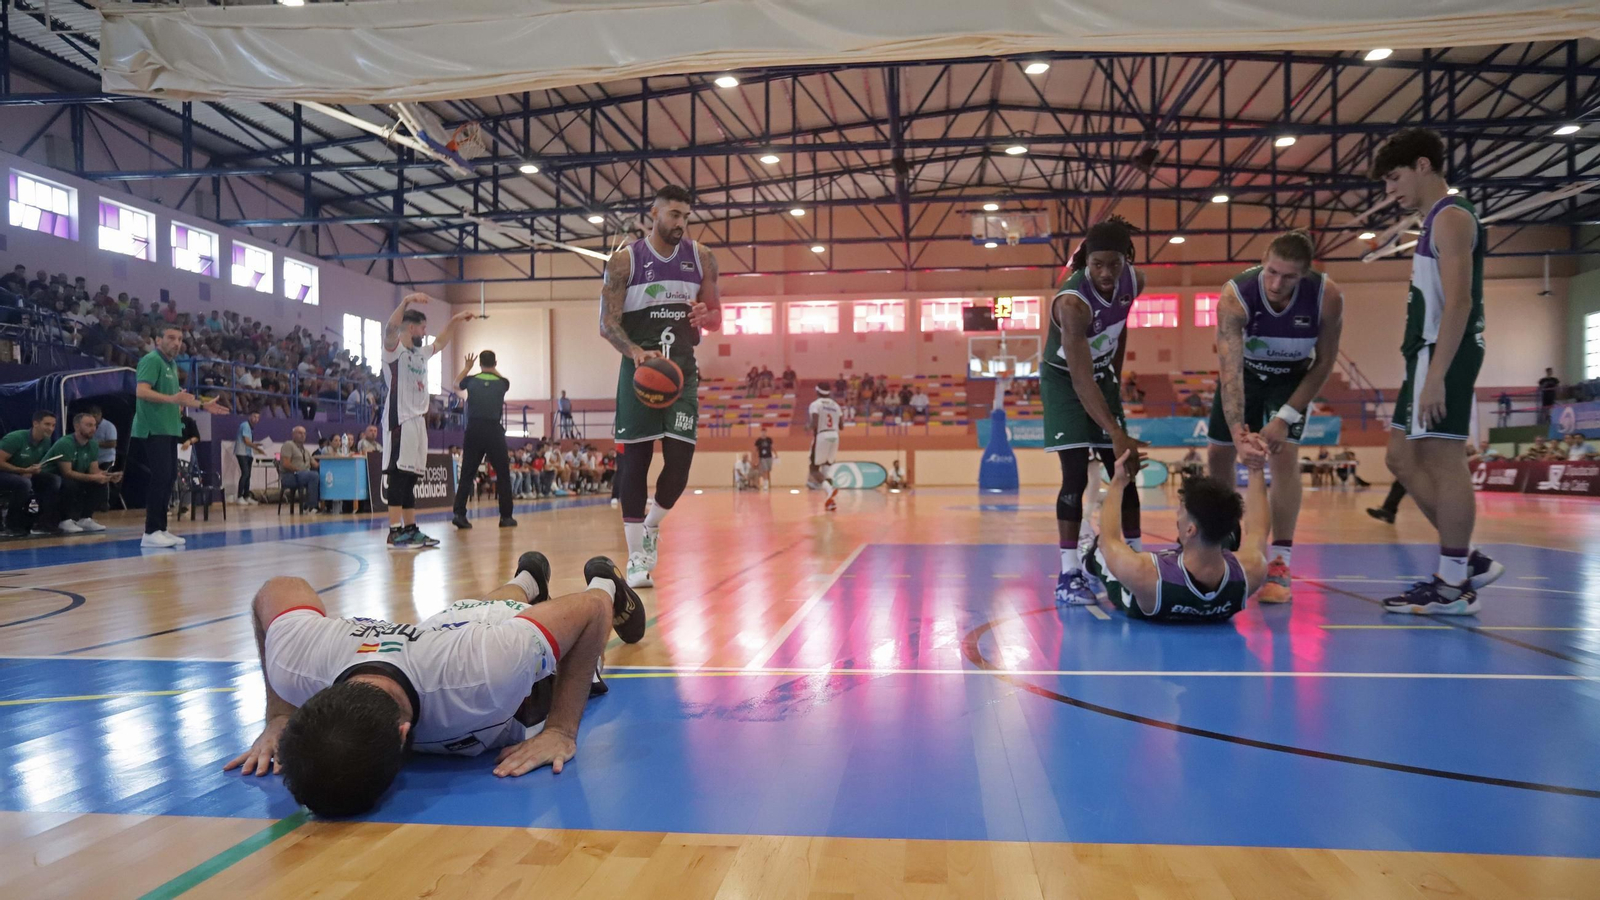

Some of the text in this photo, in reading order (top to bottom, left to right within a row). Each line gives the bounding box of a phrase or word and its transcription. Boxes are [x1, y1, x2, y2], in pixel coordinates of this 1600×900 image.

[650, 308, 686, 320] málaga
[660, 326, 676, 345] 6
[1266, 349, 1302, 359] Unicaja
